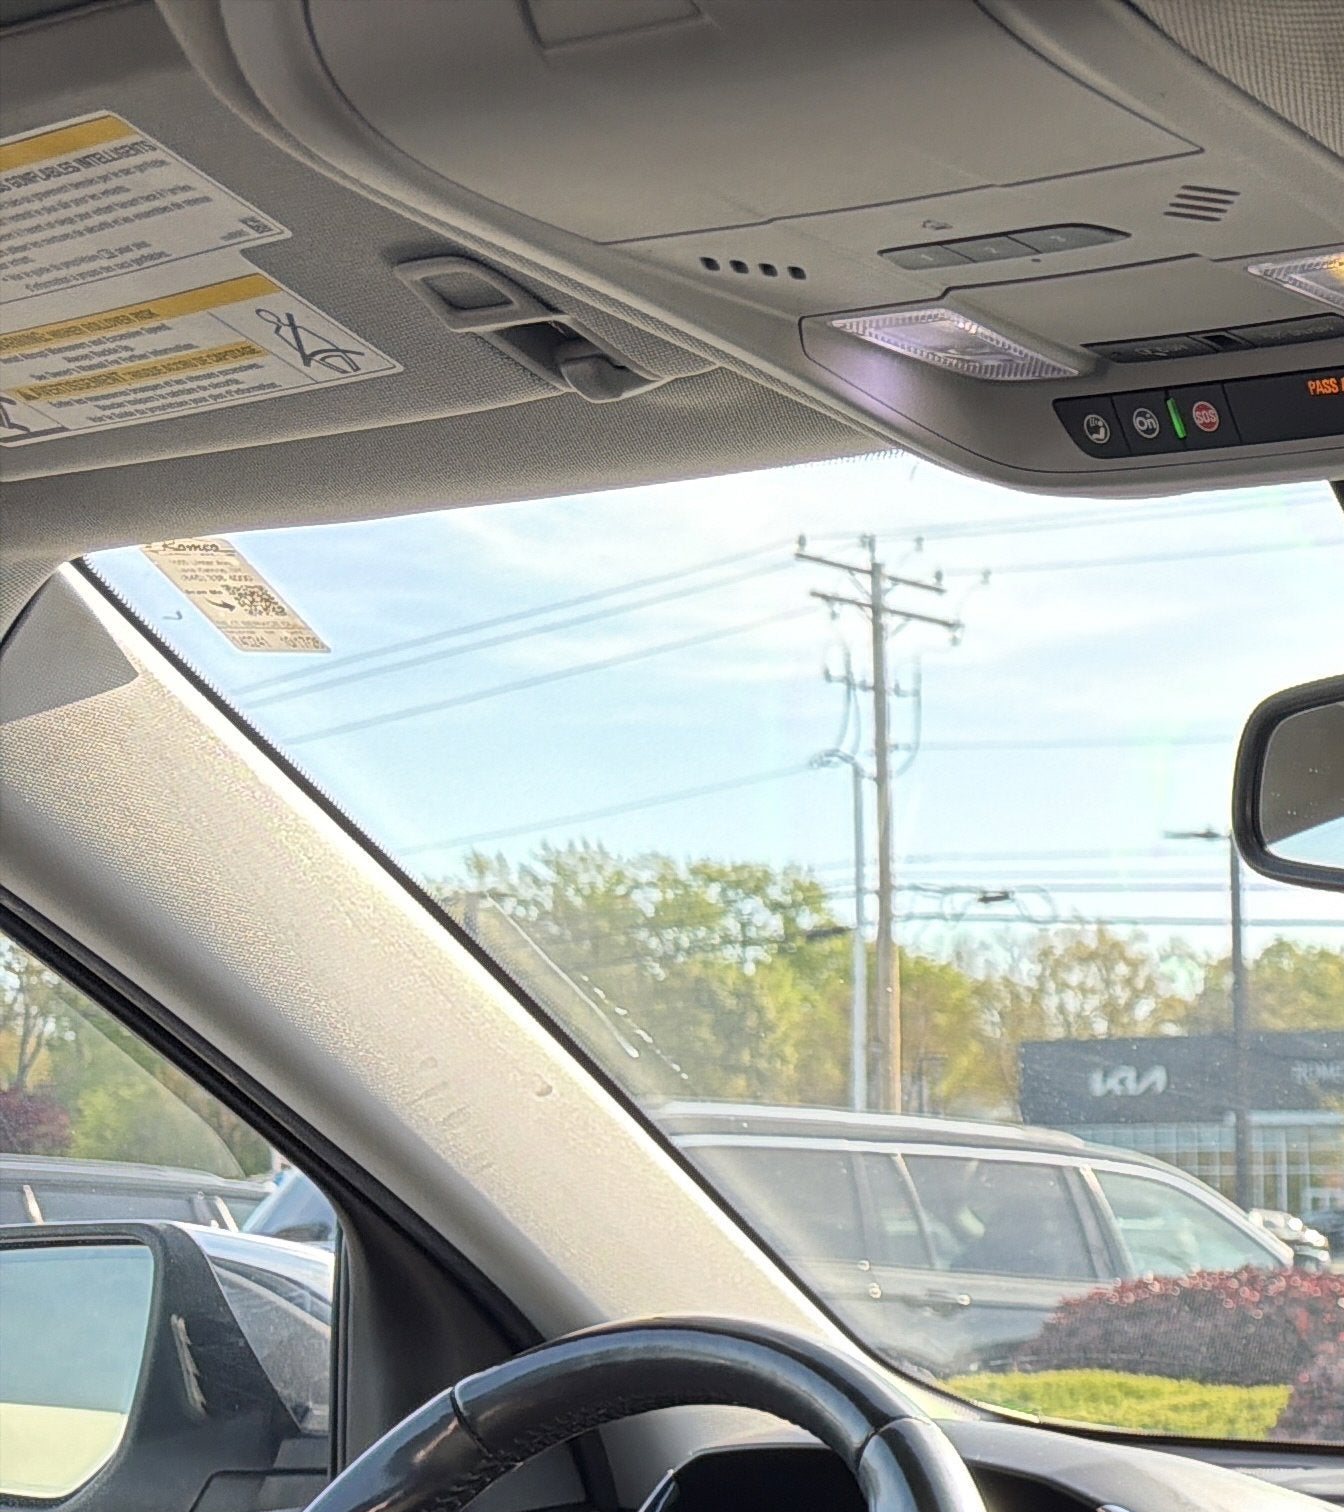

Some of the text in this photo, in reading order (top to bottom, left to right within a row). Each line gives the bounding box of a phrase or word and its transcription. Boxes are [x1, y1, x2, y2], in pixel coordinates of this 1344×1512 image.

[1307, 379, 1339, 396] PASS
[1194, 408, 1217, 425] SOS
[1088, 1064, 1168, 1097] KIA
